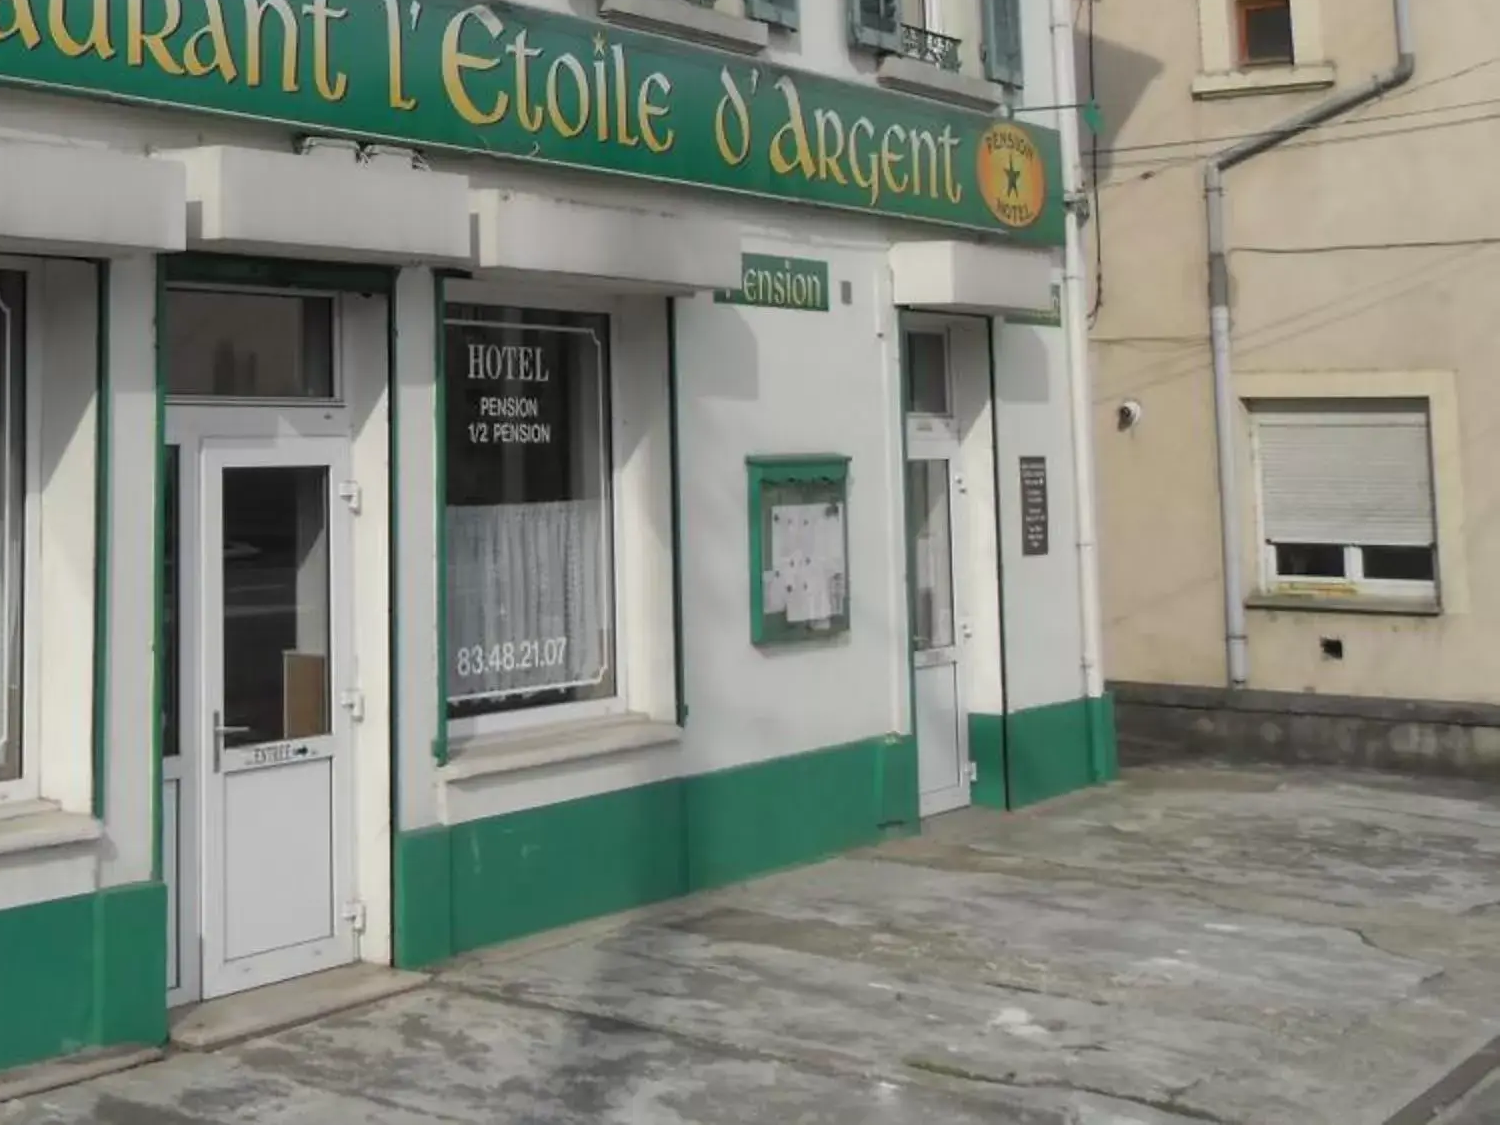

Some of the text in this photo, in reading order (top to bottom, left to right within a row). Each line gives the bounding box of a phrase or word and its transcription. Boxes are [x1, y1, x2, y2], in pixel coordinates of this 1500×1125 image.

[725, 259, 822, 308] ension
[467, 343, 550, 383] HOTEL
[480, 396, 539, 418] PENSION
[468, 422, 551, 444] 1/2 PENSION
[456, 635, 568, 677] 83.48.21.07
